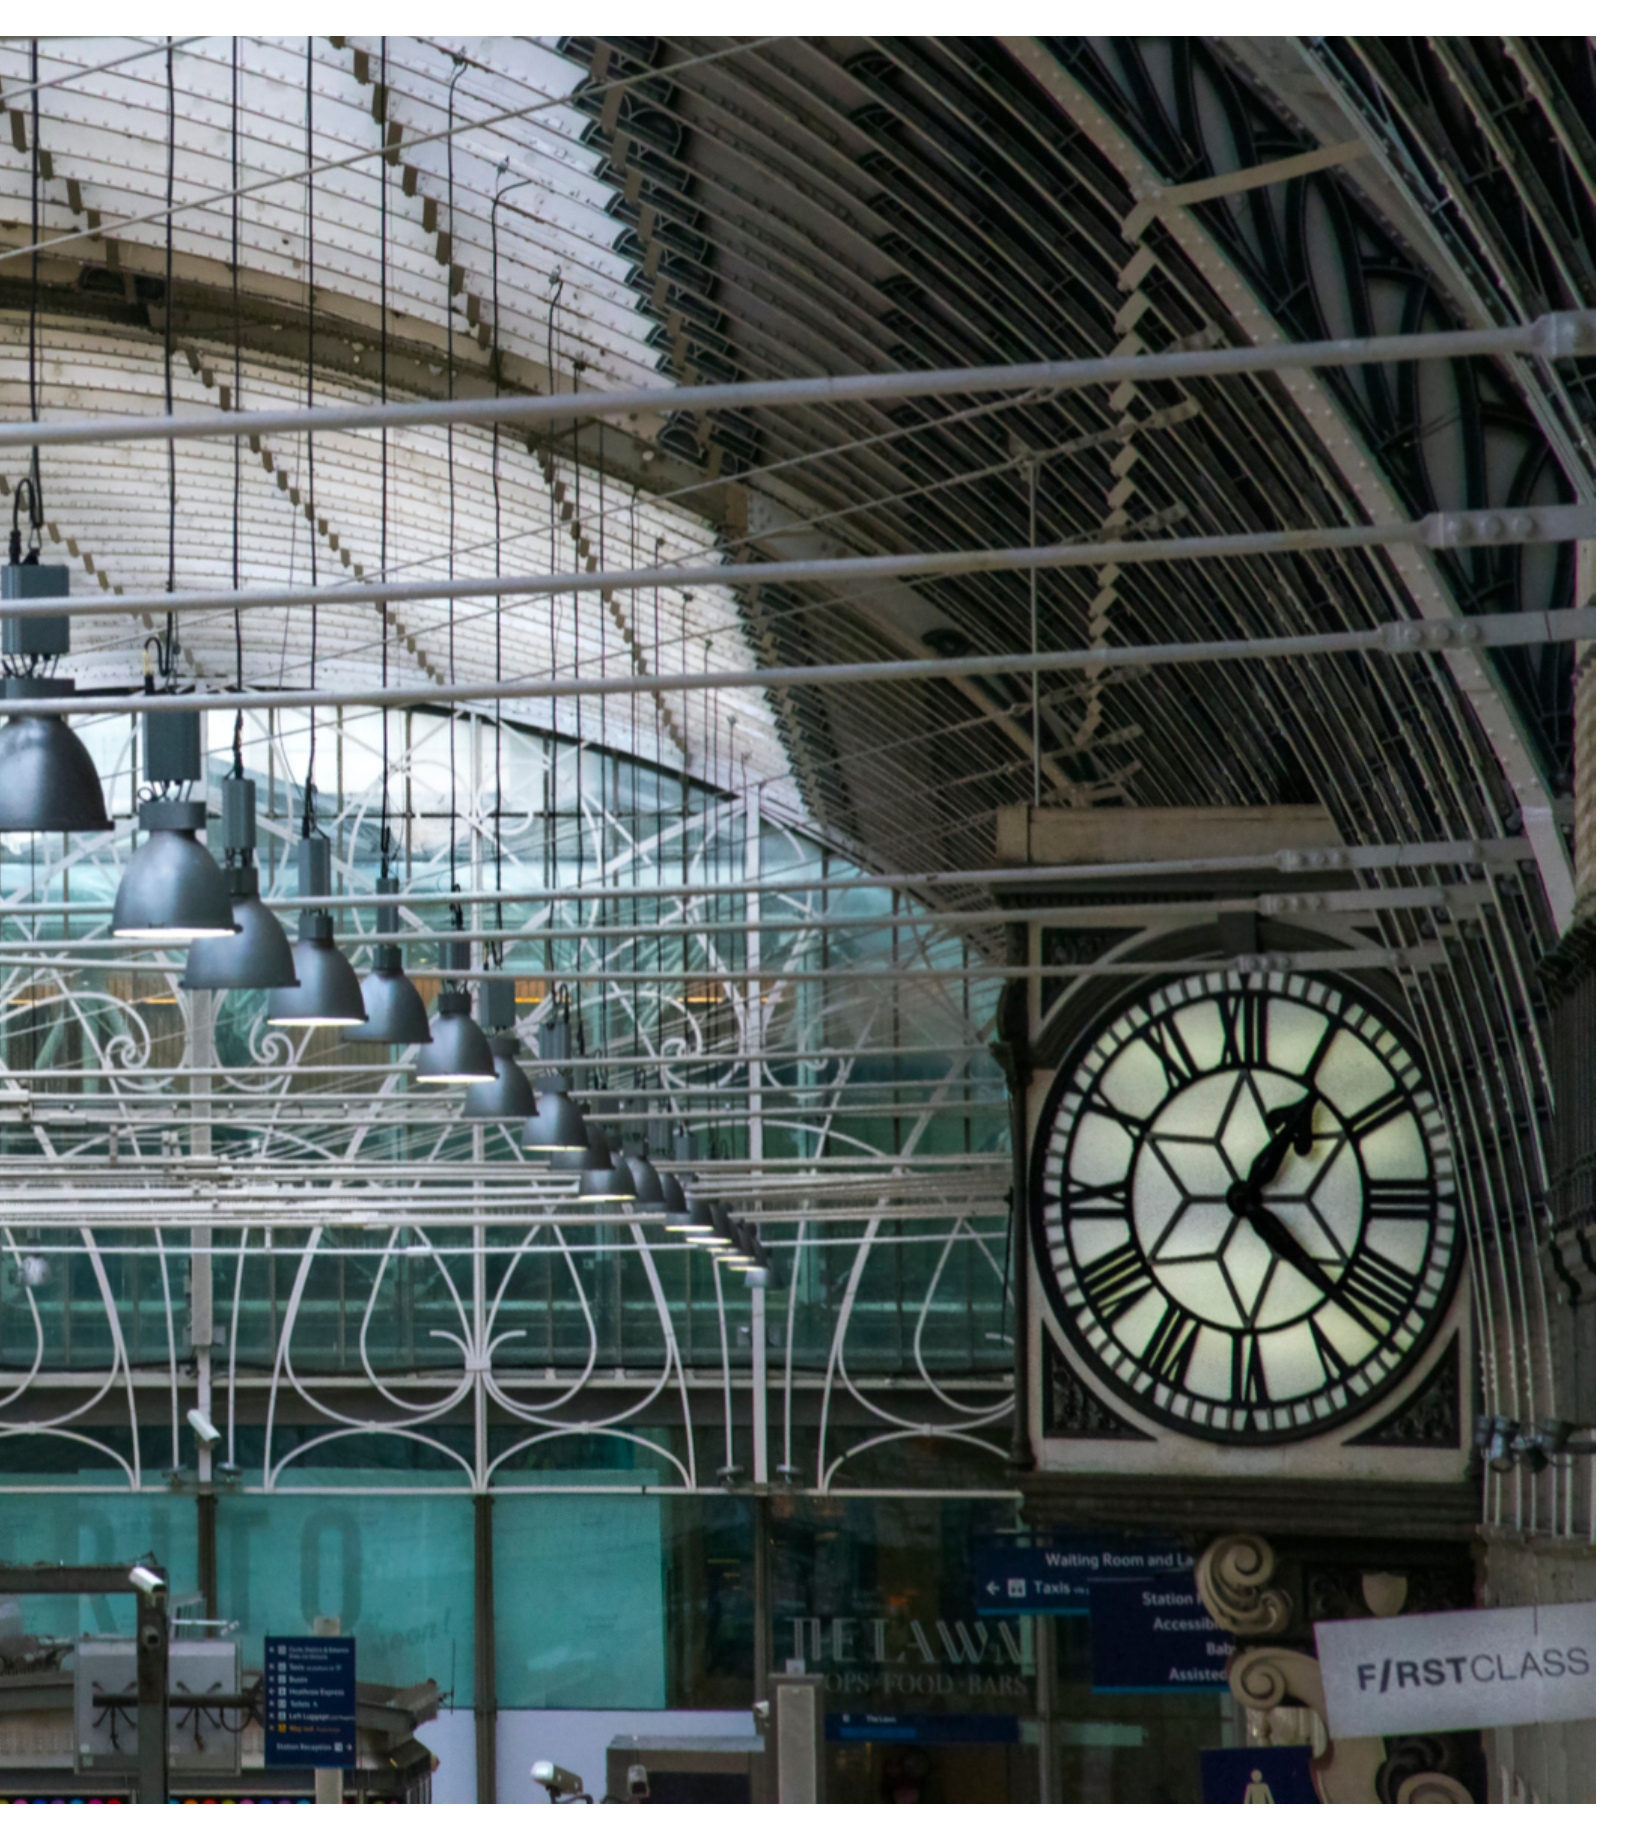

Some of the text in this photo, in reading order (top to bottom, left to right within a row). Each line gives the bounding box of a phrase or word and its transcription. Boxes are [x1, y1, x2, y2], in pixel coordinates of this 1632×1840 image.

[1218, 994, 1268, 1068] XII
[1066, 1178, 1127, 1219] IX
[1367, 1179, 1433, 1220] III
[1231, 1333, 1269, 1402] VI
[1045, 1552, 1194, 1570] Waiting Room and La
[1034, 1580, 1070, 1594] Taxis
[1142, 1591, 1193, 1606] Station
[824, 1672, 870, 1693] OPS
